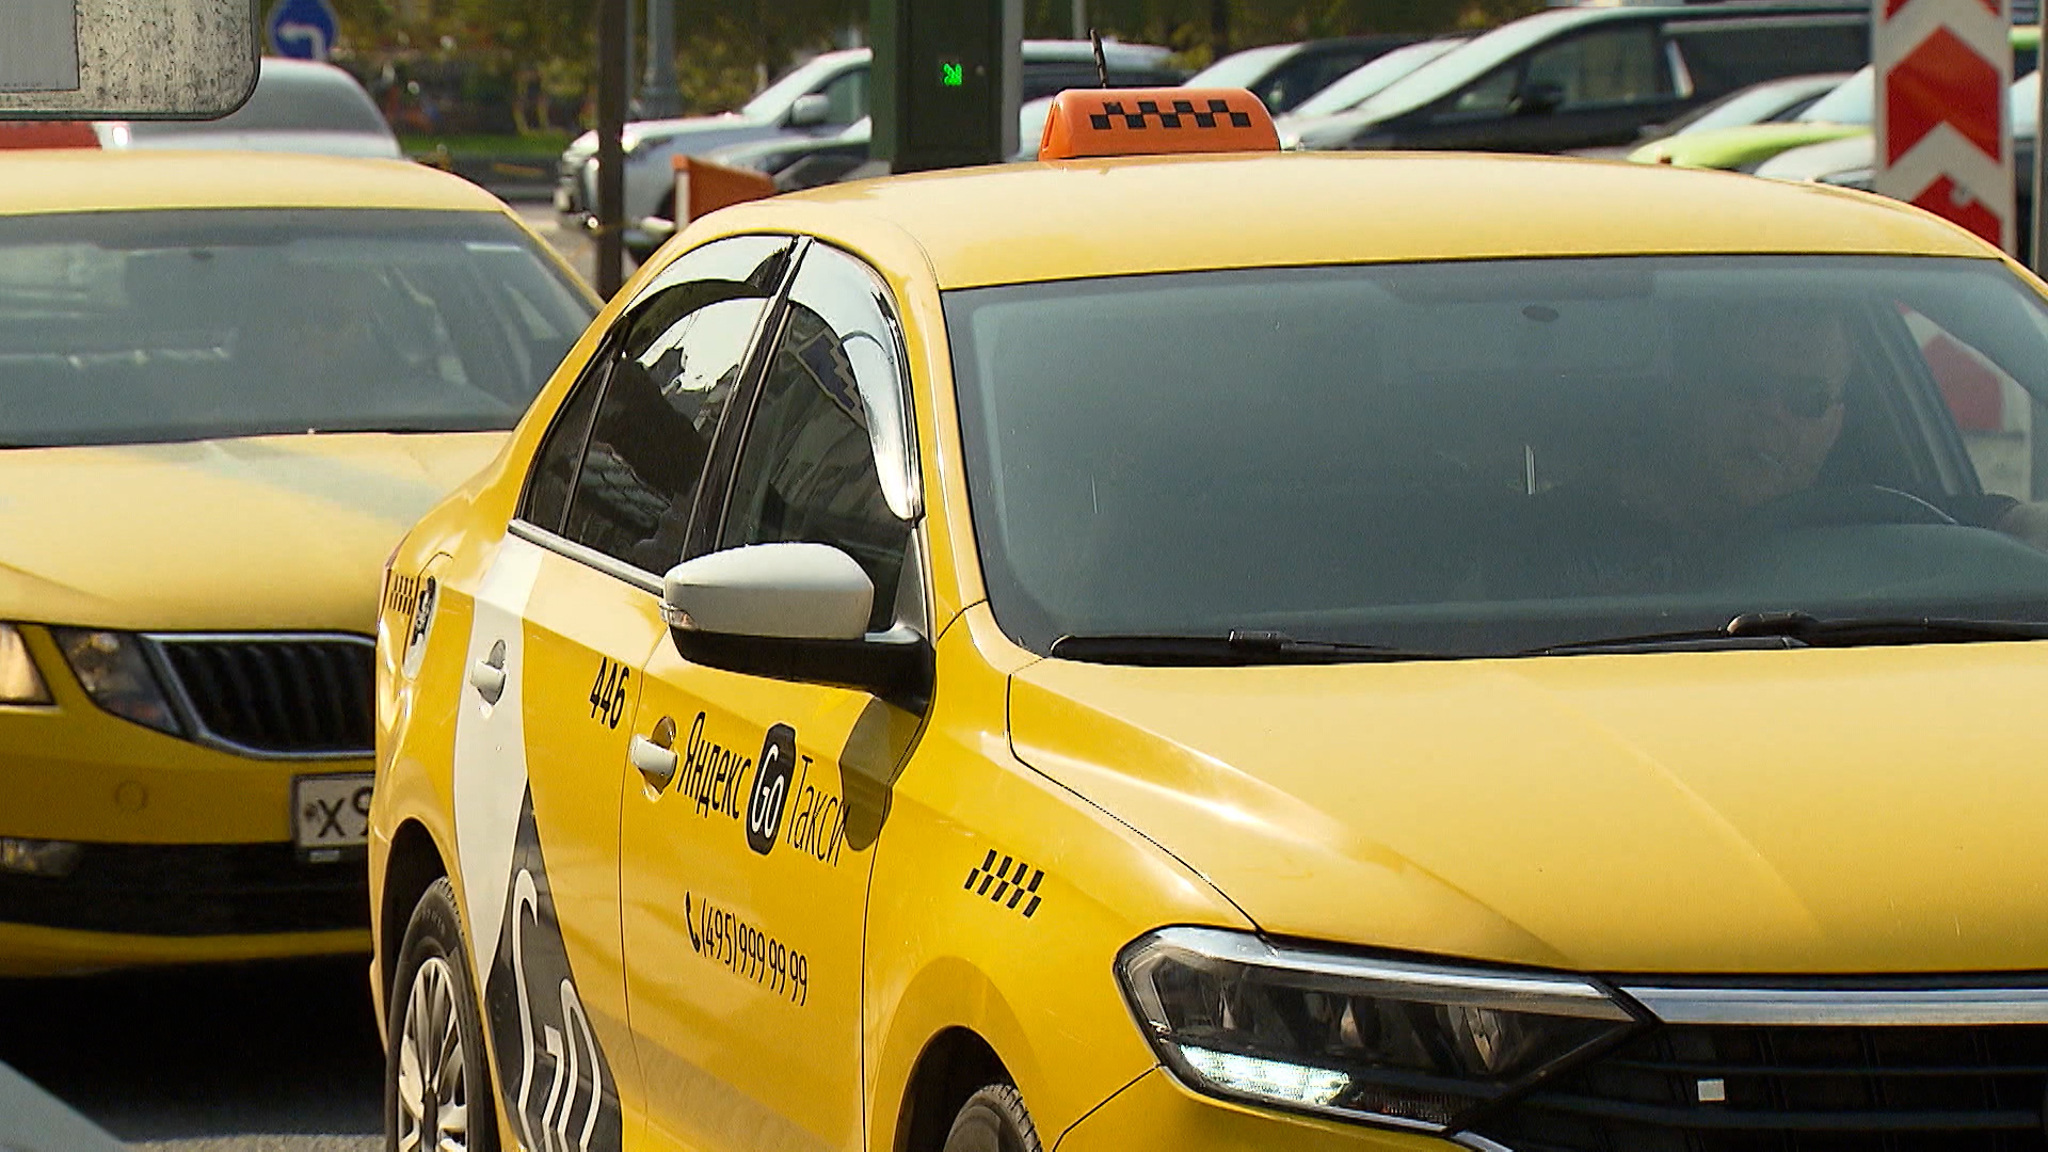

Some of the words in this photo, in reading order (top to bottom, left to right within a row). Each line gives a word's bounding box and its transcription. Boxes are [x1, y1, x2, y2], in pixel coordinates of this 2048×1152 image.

[589, 656, 629, 729] 446
[676, 711, 752, 819] Яндекс
[751, 743, 785, 839] Go
[787, 754, 851, 868] Такси
[768, 938, 787, 996] 99
[789, 949, 808, 1007] 99
